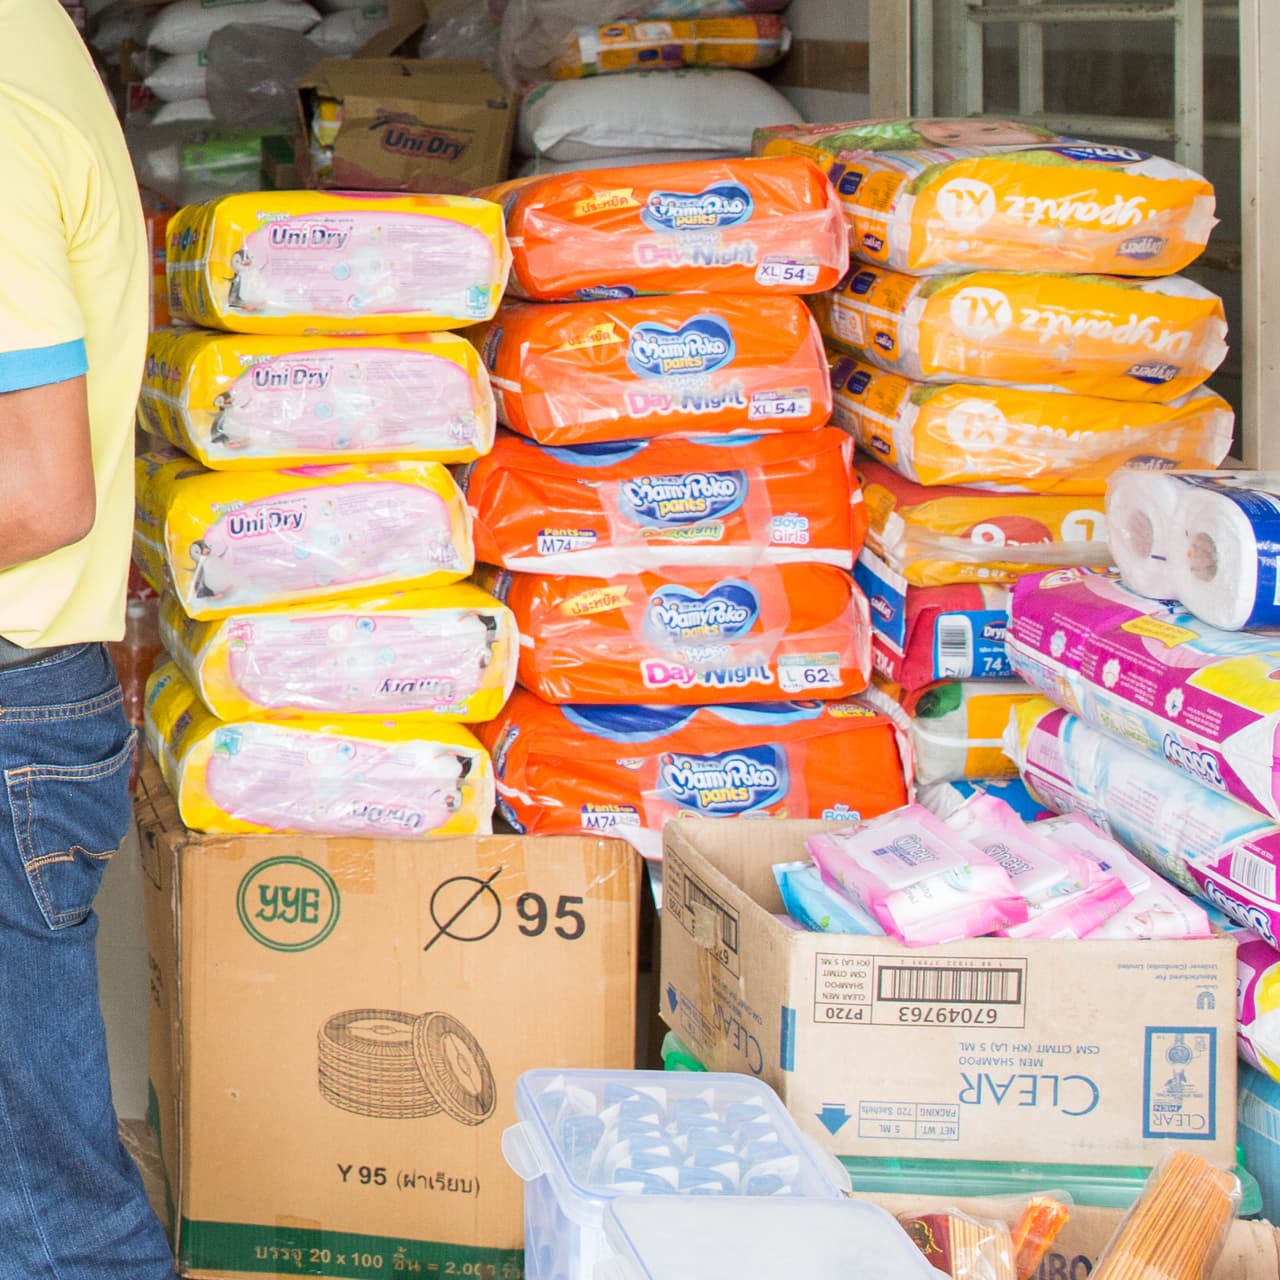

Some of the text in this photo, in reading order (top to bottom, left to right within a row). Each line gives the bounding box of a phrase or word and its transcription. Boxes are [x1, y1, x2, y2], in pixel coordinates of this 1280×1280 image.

[760, 265, 805, 281] XL 54
[663, 357, 703, 371] pants
[752, 402, 797, 415] XL 54
[660, 497, 706, 514] pants
[772, 529, 807, 543] Girls
[646, 660, 771, 686] Day Night
[786, 668, 828, 682] L 62
[662, 763, 776, 791] MamyPoko
[700, 786, 749, 803] pants
[516, 893, 586, 940] 95
[824, 982, 864, 990] SHAMPOO
[822, 993, 840, 1001] MEN
[826, 1007, 863, 1020] P720
[898, 1006, 997, 1023] 67049763
[960, 1042, 977, 1051] ML
[1076, 1045, 1100, 1054] CSM
[959, 1057, 1044, 1067] MEN SHAMPOO
[959, 1073, 1100, 1116] CLEAR
[897, 1108, 912, 1116] 720
[920, 1109, 956, 1118] PACKING
[880, 1124, 892, 1133] ML
[1153, 1113, 1205, 1130] CLEAR
[940, 1126, 956, 1135] NET
[337, 1165, 353, 1185] Y
[358, 1167, 387, 1186] 95
[255, 1245, 304, 1267] บรรจุ
[309, 1247, 332, 1264] 20
[351, 1251, 384, 1269] 100
